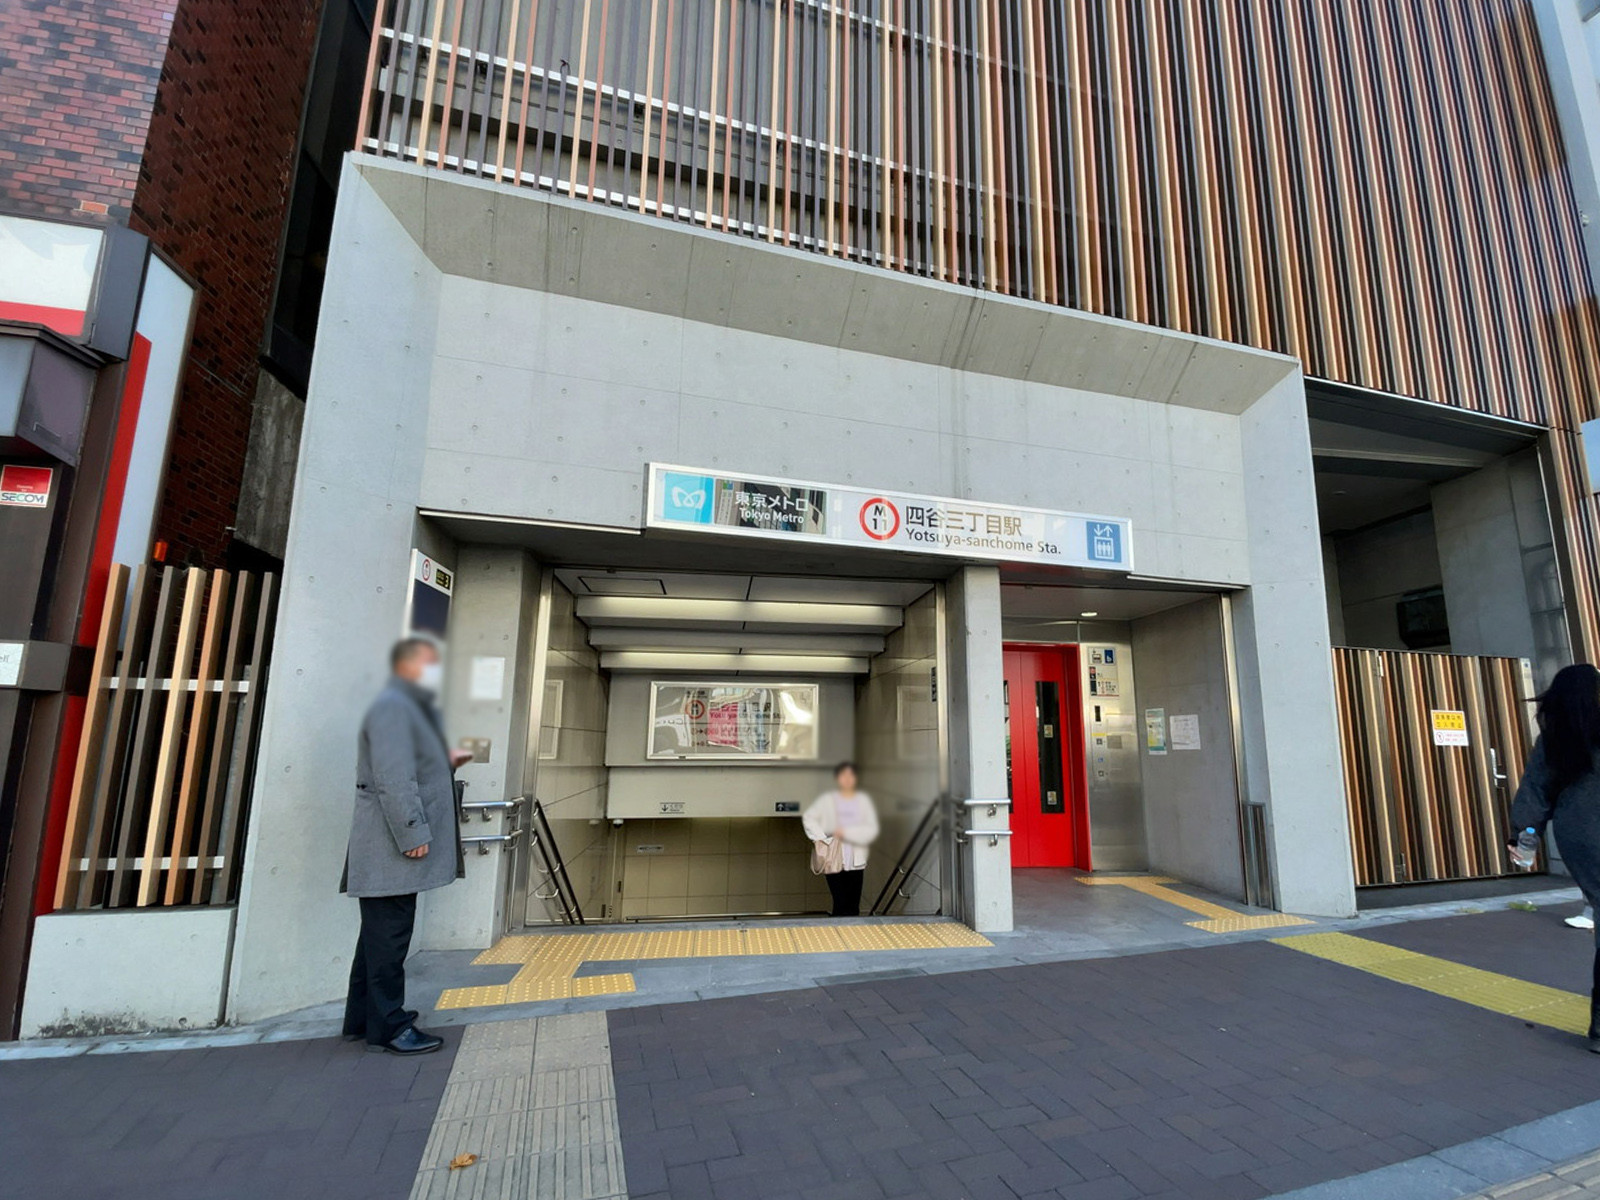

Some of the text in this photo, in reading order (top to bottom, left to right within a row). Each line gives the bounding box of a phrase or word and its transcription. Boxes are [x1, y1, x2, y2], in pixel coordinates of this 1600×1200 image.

[1, 492, 45, 503] SECOM
[735, 491, 809, 512] 東京メトロ
[739, 507, 805, 524] Tokyo Metro
[874, 505, 887, 517] M
[873, 518, 887, 531] 11
[905, 506, 1022, 537] 四谷三丁目駅
[905, 527, 1062, 554] Yotsuya-sanchome Sta.
